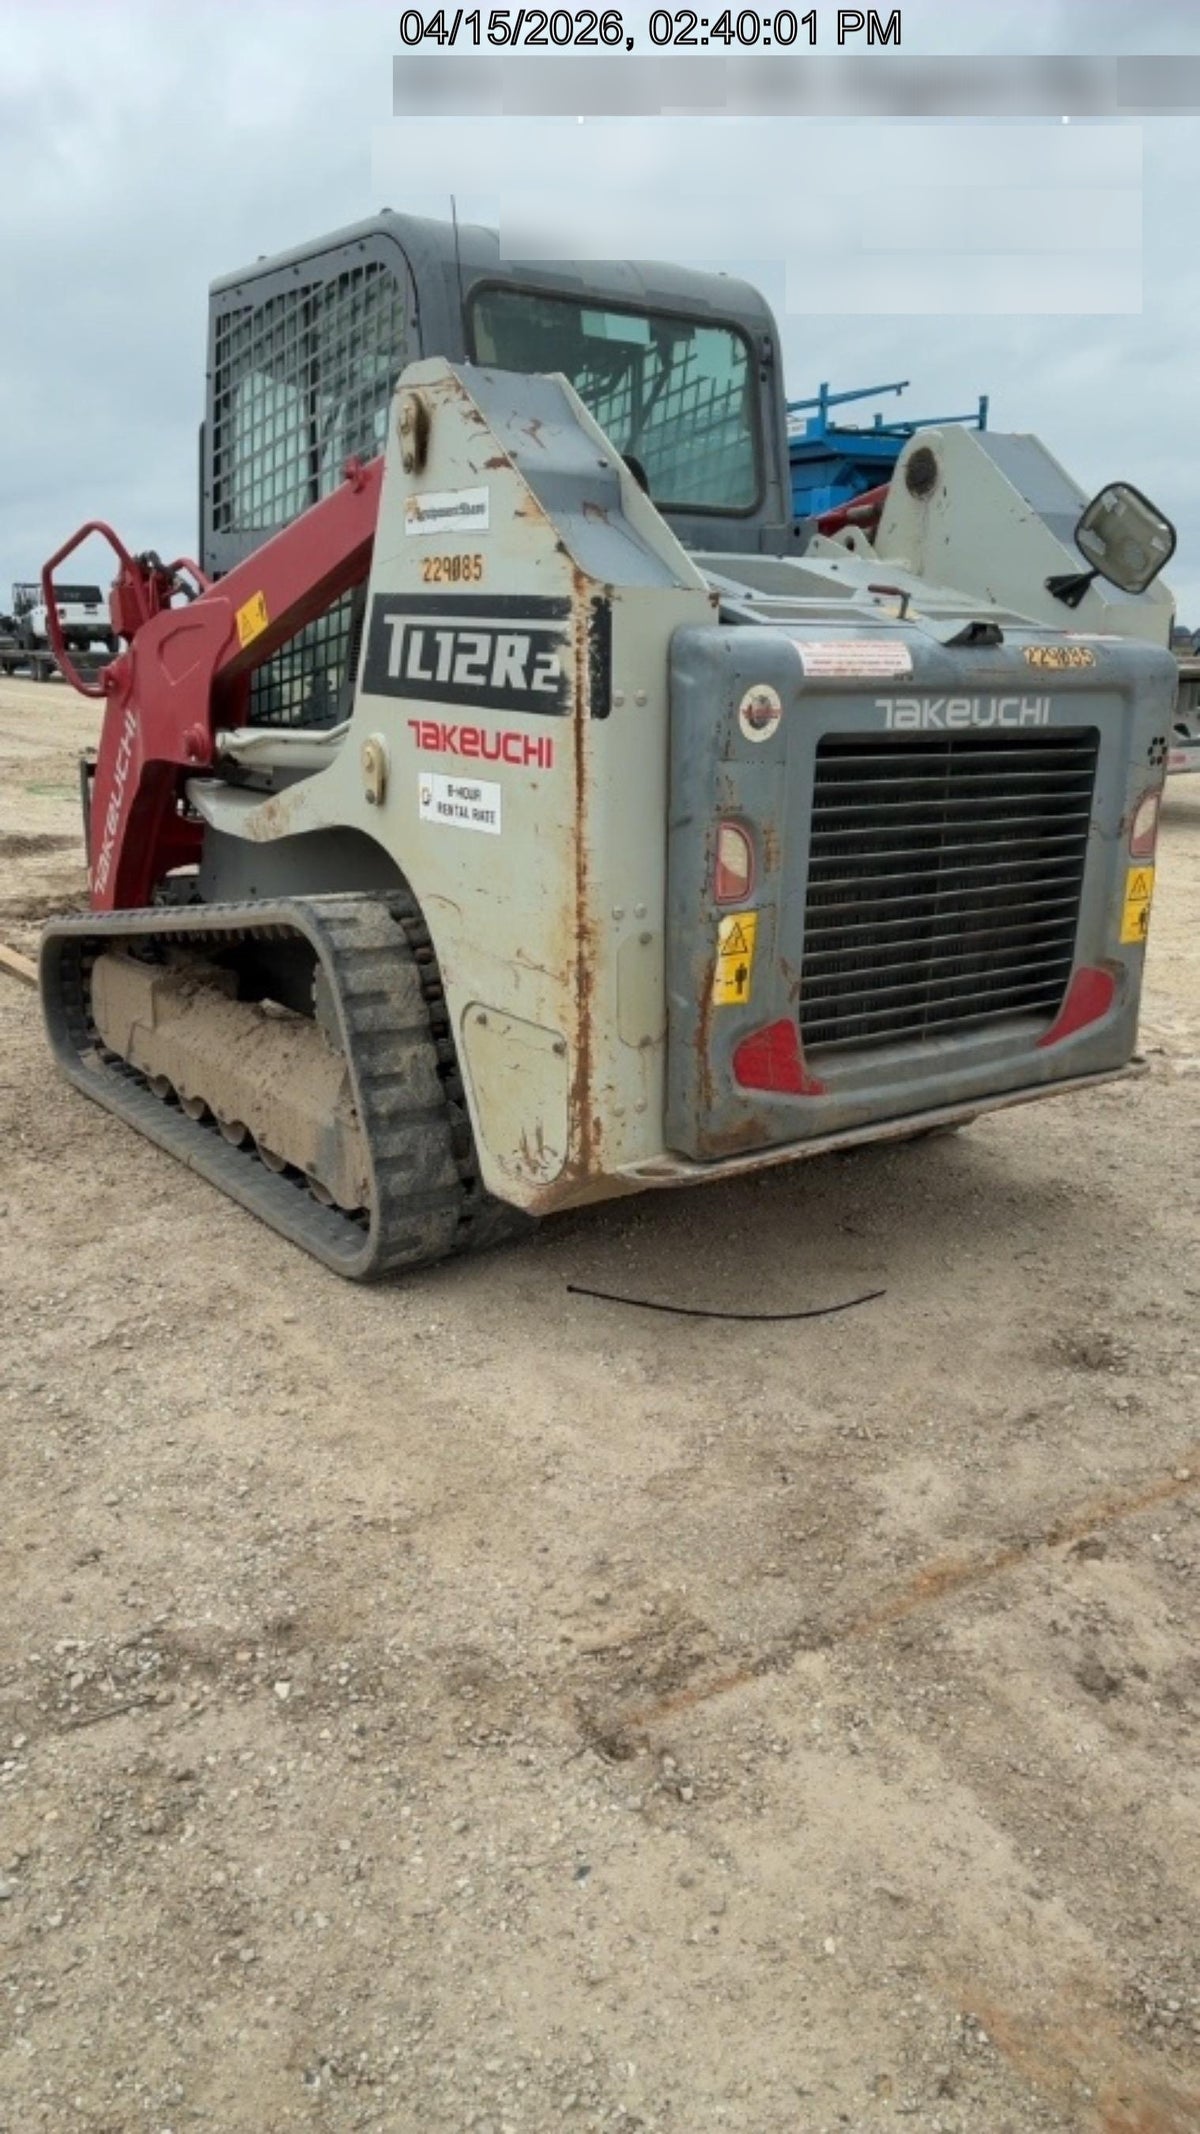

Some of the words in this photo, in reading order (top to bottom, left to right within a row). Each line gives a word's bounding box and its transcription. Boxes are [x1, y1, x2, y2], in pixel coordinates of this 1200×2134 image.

[423, 554, 482, 582] 229085
[875, 697, 1050, 729] TAKEUCHI
[407, 719, 554, 769] TAKEUCHI
[94, 710, 137, 894] TAKEUCHI
